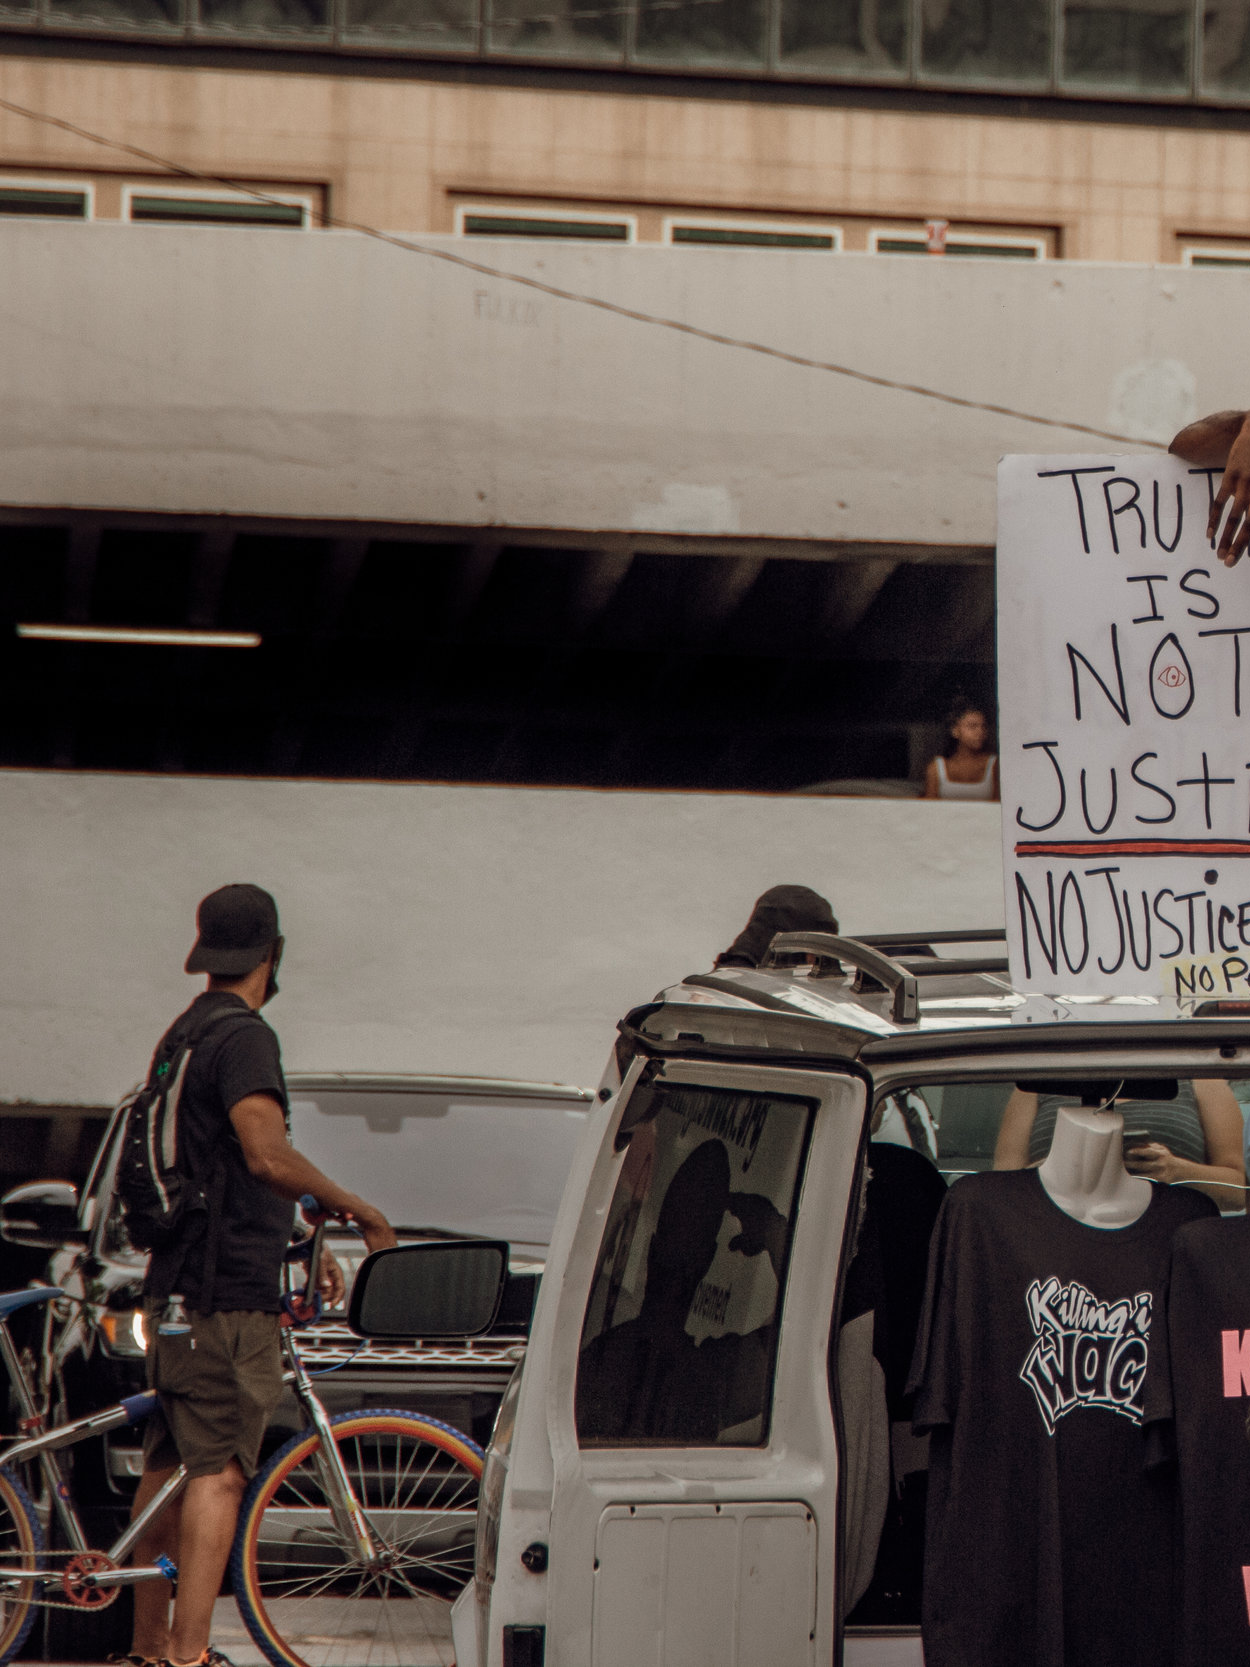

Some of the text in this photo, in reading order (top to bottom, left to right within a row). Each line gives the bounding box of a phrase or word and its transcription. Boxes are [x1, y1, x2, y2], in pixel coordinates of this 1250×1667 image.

[1126, 569, 1220, 623] IS
[1014, 871, 1089, 979] NO
[1027, 1277, 1128, 1336] Killing
